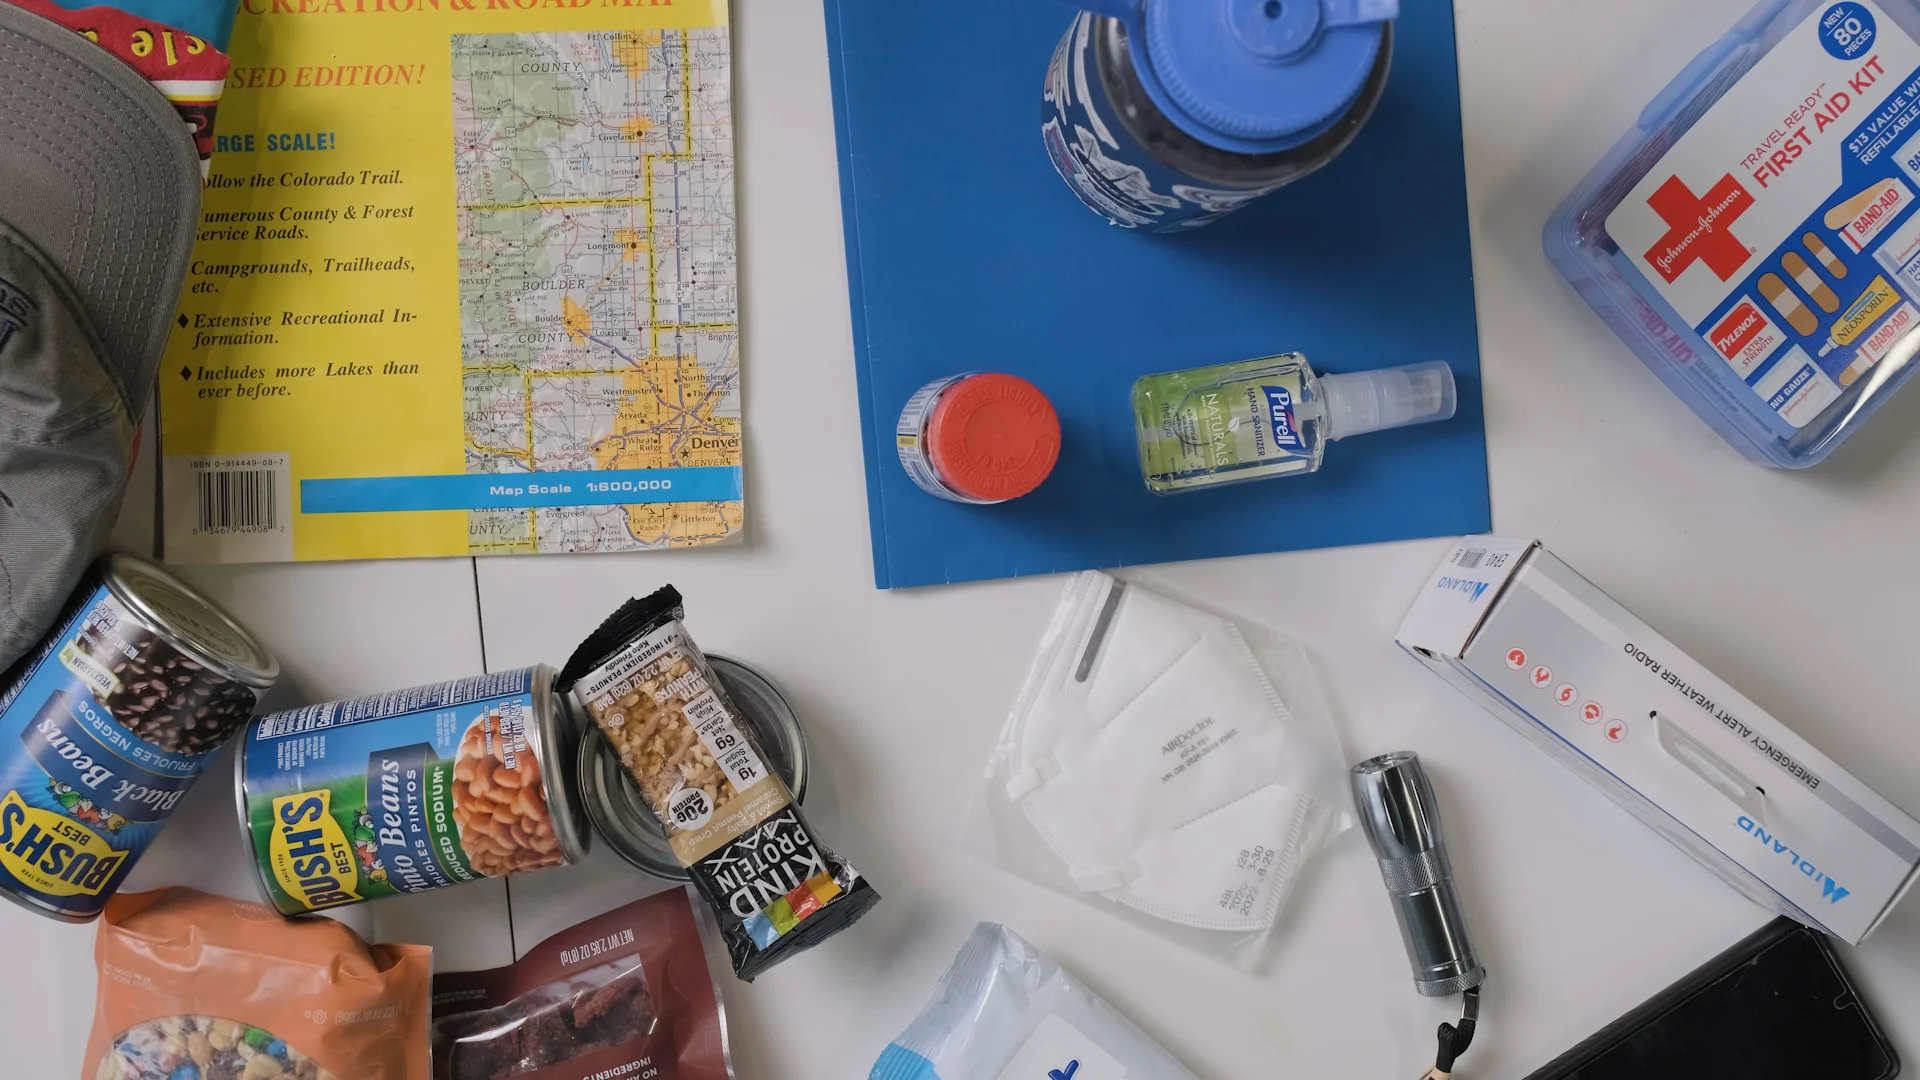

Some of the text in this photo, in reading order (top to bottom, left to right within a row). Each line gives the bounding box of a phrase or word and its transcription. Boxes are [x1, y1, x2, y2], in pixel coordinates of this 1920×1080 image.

[237, 0, 440, 15] CREATION
[1823, 7, 1844, 29] NEW
[604, 32, 632, 41] Collins
[1833, 18, 1862, 46] 80
[1844, 28, 1872, 56] PIECES
[294, 64, 426, 87] EDITION!
[521, 62, 581, 73] COUNTY
[1753, 55, 1885, 188] FIRST AID KIT
[1849, 96, 1906, 153] $13 VALUE
[267, 132, 336, 151] SCALE!
[599, 133, 635, 141] Loveland
[1861, 105, 1919, 165] REFILLABLE
[1740, 128, 1787, 170] TRAVEL
[206, 170, 404, 189] ollow the Colorado Trail.
[201, 204, 415, 224] umerous County & Forest
[1853, 188, 1899, 234] BAND-AID
[196, 225, 309, 241] ervice Roads.
[587, 242, 629, 251] Longmont
[191, 256, 415, 278] Campgrounds, Trailheads,
[192, 280, 220, 294] etc.
[522, 280, 586, 291] BOULDER
[194, 308, 418, 329] Extensive Recreational In-
[535, 315, 566, 323] Boulder
[637, 319, 674, 327] Lafayette
[1837, 288, 1889, 341] NEOSPORIN
[192, 330, 279, 350] formation.
[518, 333, 574, 343] COUNTY
[595, 329, 630, 337] Louisville
[1716, 310, 1758, 354] TYLENOL
[1868, 309, 1910, 352] BAND-AID
[1743, 336, 1765, 357] EXTRA
[1743, 335, 1774, 367] STRENGTH
[197, 361, 419, 381] Includes more Lakes than
[681, 374, 727, 382] Northglenn
[198, 381, 291, 400] ever before.
[602, 388, 652, 396] Westminster
[693, 389, 731, 397] Thornton
[1770, 369, 1810, 410] NU GAUZE
[1206, 393, 1229, 466] NATURALS
[1247, 387, 1266, 457] HAND SANITIZER
[1270, 392, 1297, 446] Purell
[561, 444, 590, 452] Golden
[639, 444, 663, 452] Ridge
[691, 437, 740, 449] Denver
[215, 459, 284, 468] 0-914449-08-7
[489, 480, 672, 496] Map Scale 1:600,000
[546, 511, 584, 519] Evergreen
[680, 515, 716, 524] Littleton
[1485, 552, 1508, 568] ER40
[1437, 576, 1489, 603] MIDLAND
[590, 640, 664, 693] INGREDIENT PEANUTS
[604, 640, 650, 672] Keto Friendly
[72, 656, 111, 690] VEGETARIAN
[655, 668, 703, 701] PEANUTS
[595, 660, 657, 710] 2.2 OZ (62g) BAR
[680, 677, 709, 700] WITH
[687, 695, 713, 715] Protein
[695, 705, 714, 720] High
[1623, 642, 1820, 789] EMERGENCY ALERT WEATHER RADIO
[77, 701, 196, 771] FRIJOLES NEGROS
[498, 701, 518, 771] NET WT. PESO NETO
[714, 723, 726, 736] Net
[486, 732, 494, 755] SERVING
[714, 734, 736, 750] 6g
[36, 718, 187, 812] Black Beans
[724, 748, 746, 764] Sugar
[729, 755, 750, 771] Total
[739, 766, 758, 782] 1g
[671, 790, 701, 815] PROTEIN
[676, 797, 710, 823] 20G
[380, 758, 425, 894] Pinto Beans
[688, 788, 779, 848] Caramel Peanut Crisp
[726, 795, 784, 835] Sweet Salty
[52, 821, 91, 846] BEST
[406, 769, 451, 889] FRIJOLES PINTOS
[0, 803, 121, 890] BUSH'S
[280, 797, 347, 908] BUSH'S
[704, 808, 799, 876] MAX
[331, 842, 352, 873] BEST
[440, 836, 475, 882] REDUCED
[715, 824, 810, 894] PROTEIN
[1737, 815, 1851, 904] MIDLAND
[35, 876, 54, 888] SINCE
[280, 865, 291, 883] SINCE
[730, 845, 824, 918] KIND
[560, 929, 635, 966] NET WT 2.85 OZ (81g)
[642, 1066, 658, 1080] NO
